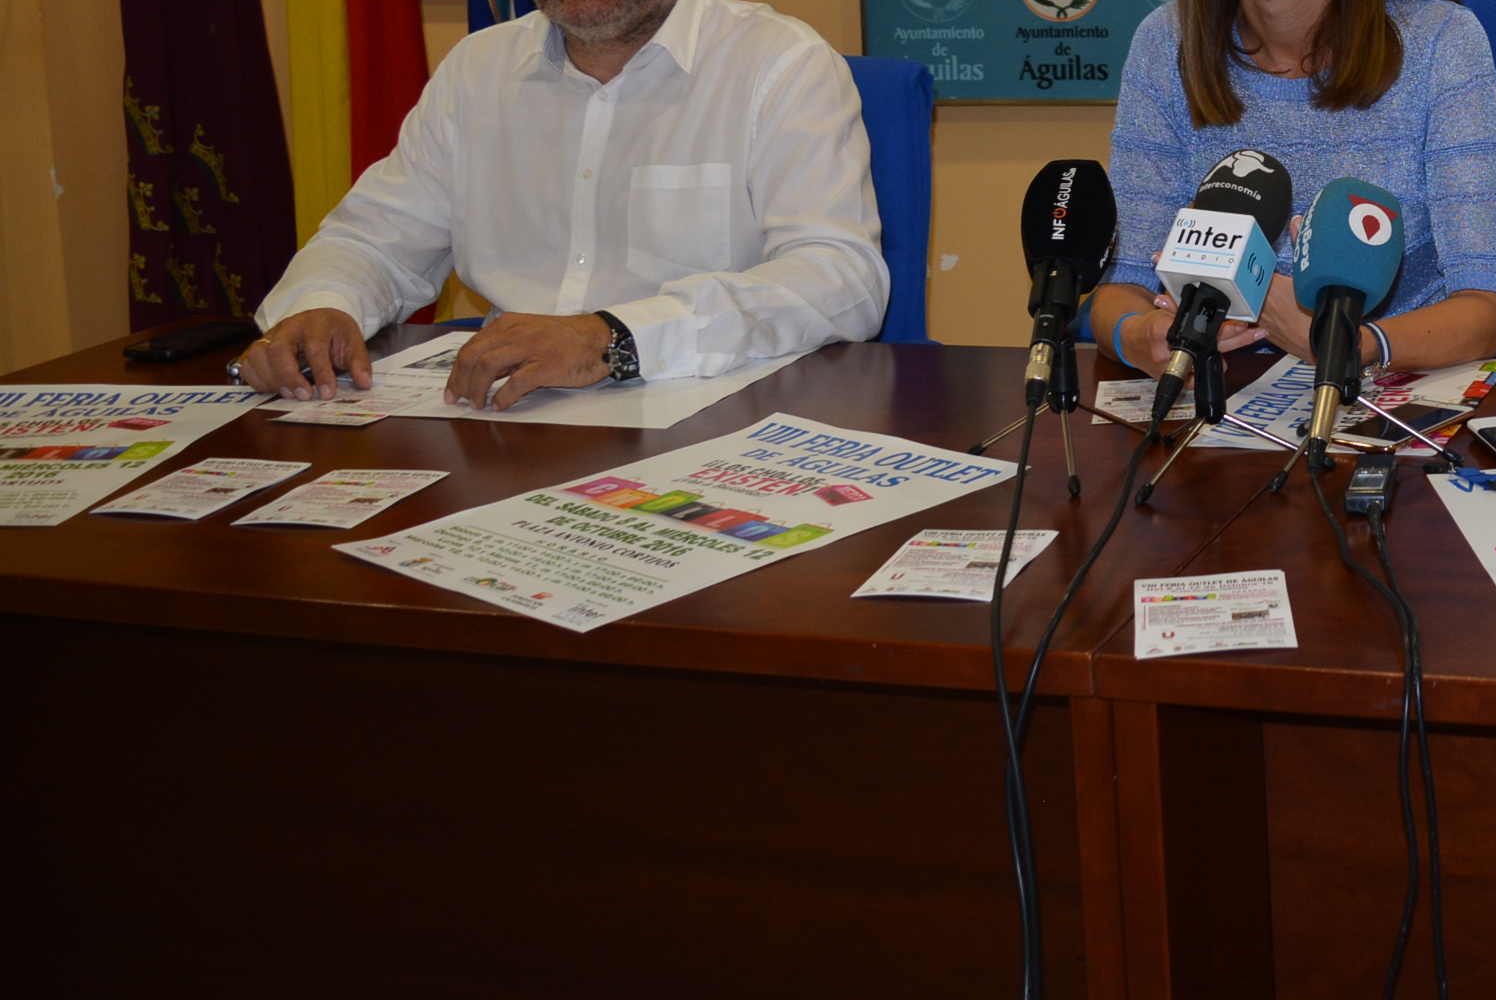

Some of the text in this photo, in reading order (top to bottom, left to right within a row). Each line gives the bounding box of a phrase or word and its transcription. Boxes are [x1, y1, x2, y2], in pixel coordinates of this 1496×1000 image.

[893, 27, 985, 44] Ayuntamiento
[1016, 26, 1109, 44] Ayuntamiento
[932, 42, 948, 57] de
[1055, 41, 1071, 55] de
[1019, 56, 1109, 90] Águilas
[1178, 227, 1243, 249] inter
[1172, 251, 1234, 264] RADIO
[25, 392, 256, 407] FERIA OUTLET
[746, 423, 1002, 484] VIII FERIA OUTLET
[740, 449, 910, 488] DE ÁGUILAS
